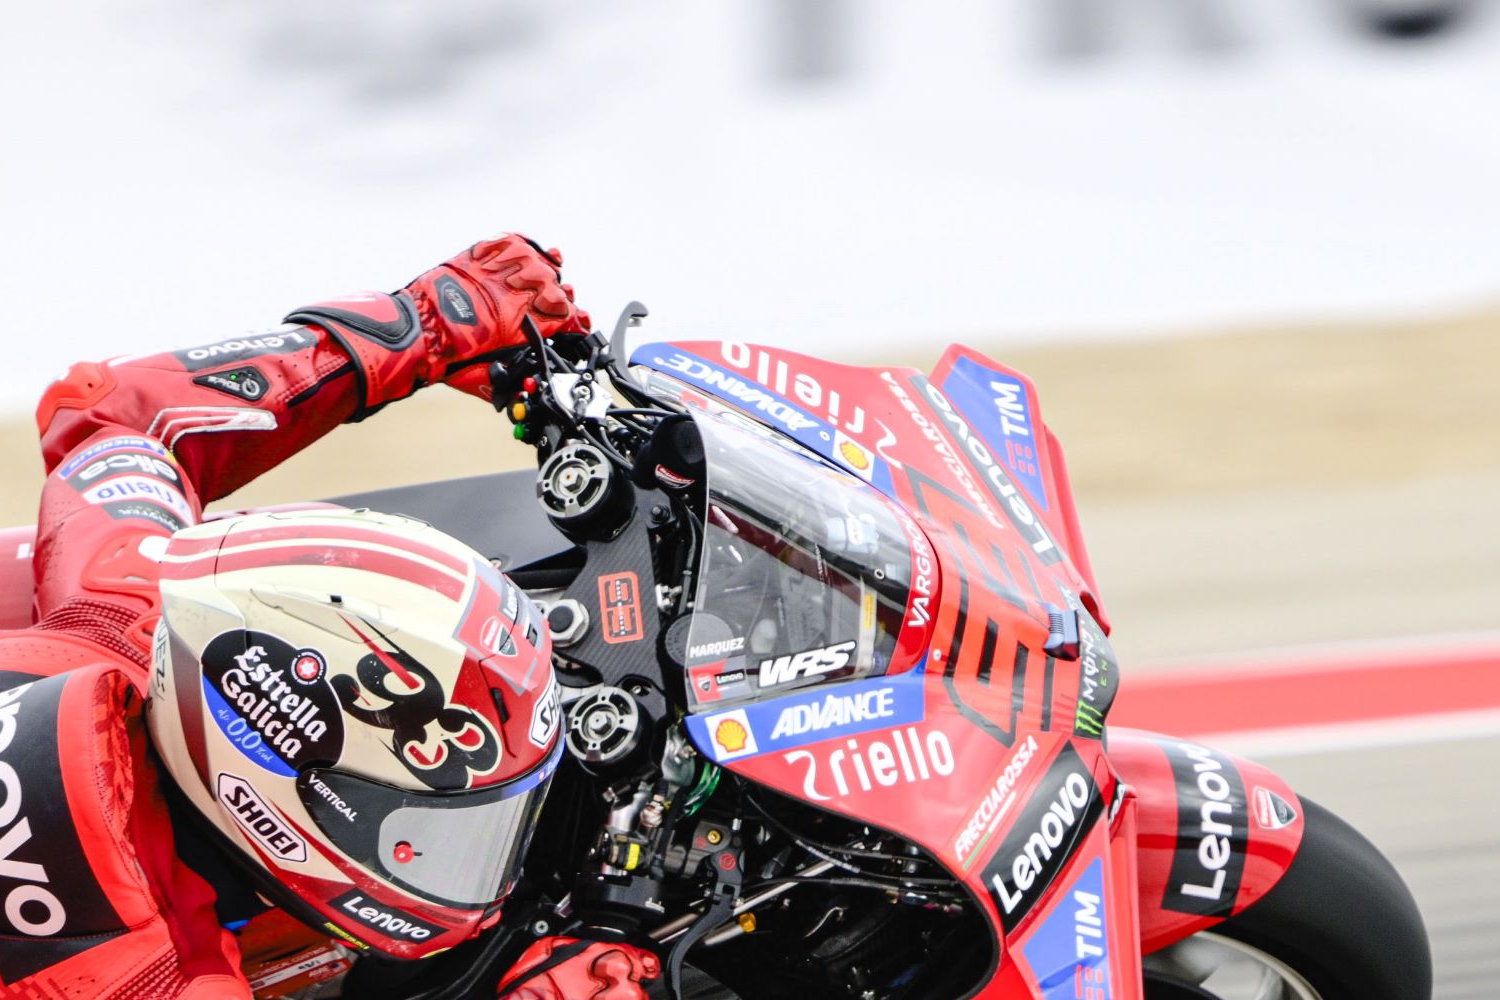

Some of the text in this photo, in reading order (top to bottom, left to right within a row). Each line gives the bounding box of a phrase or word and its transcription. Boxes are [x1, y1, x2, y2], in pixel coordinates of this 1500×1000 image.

[187, 331, 305, 361] Lenovo
[666, 353, 821, 432] ADVANCE
[720, 341, 865, 434] riello
[990, 380, 1030, 436] TIM
[924, 383, 1054, 554] Lenovo
[689, 637, 745, 659] MARQUEZ
[759, 641, 856, 688] WRS
[220, 668, 303, 759] Galicia
[233, 645, 328, 743] Estrella
[769, 687, 894, 741] ADVANCE
[224, 785, 300, 856] SHOEI
[308, 773, 358, 823] VERTICAL
[953, 735, 1039, 862] FRECCIAROSSA
[991, 772, 1089, 915] Lenovo
[342, 895, 432, 940] Lenovo
[1074, 889, 1104, 959] TIM
